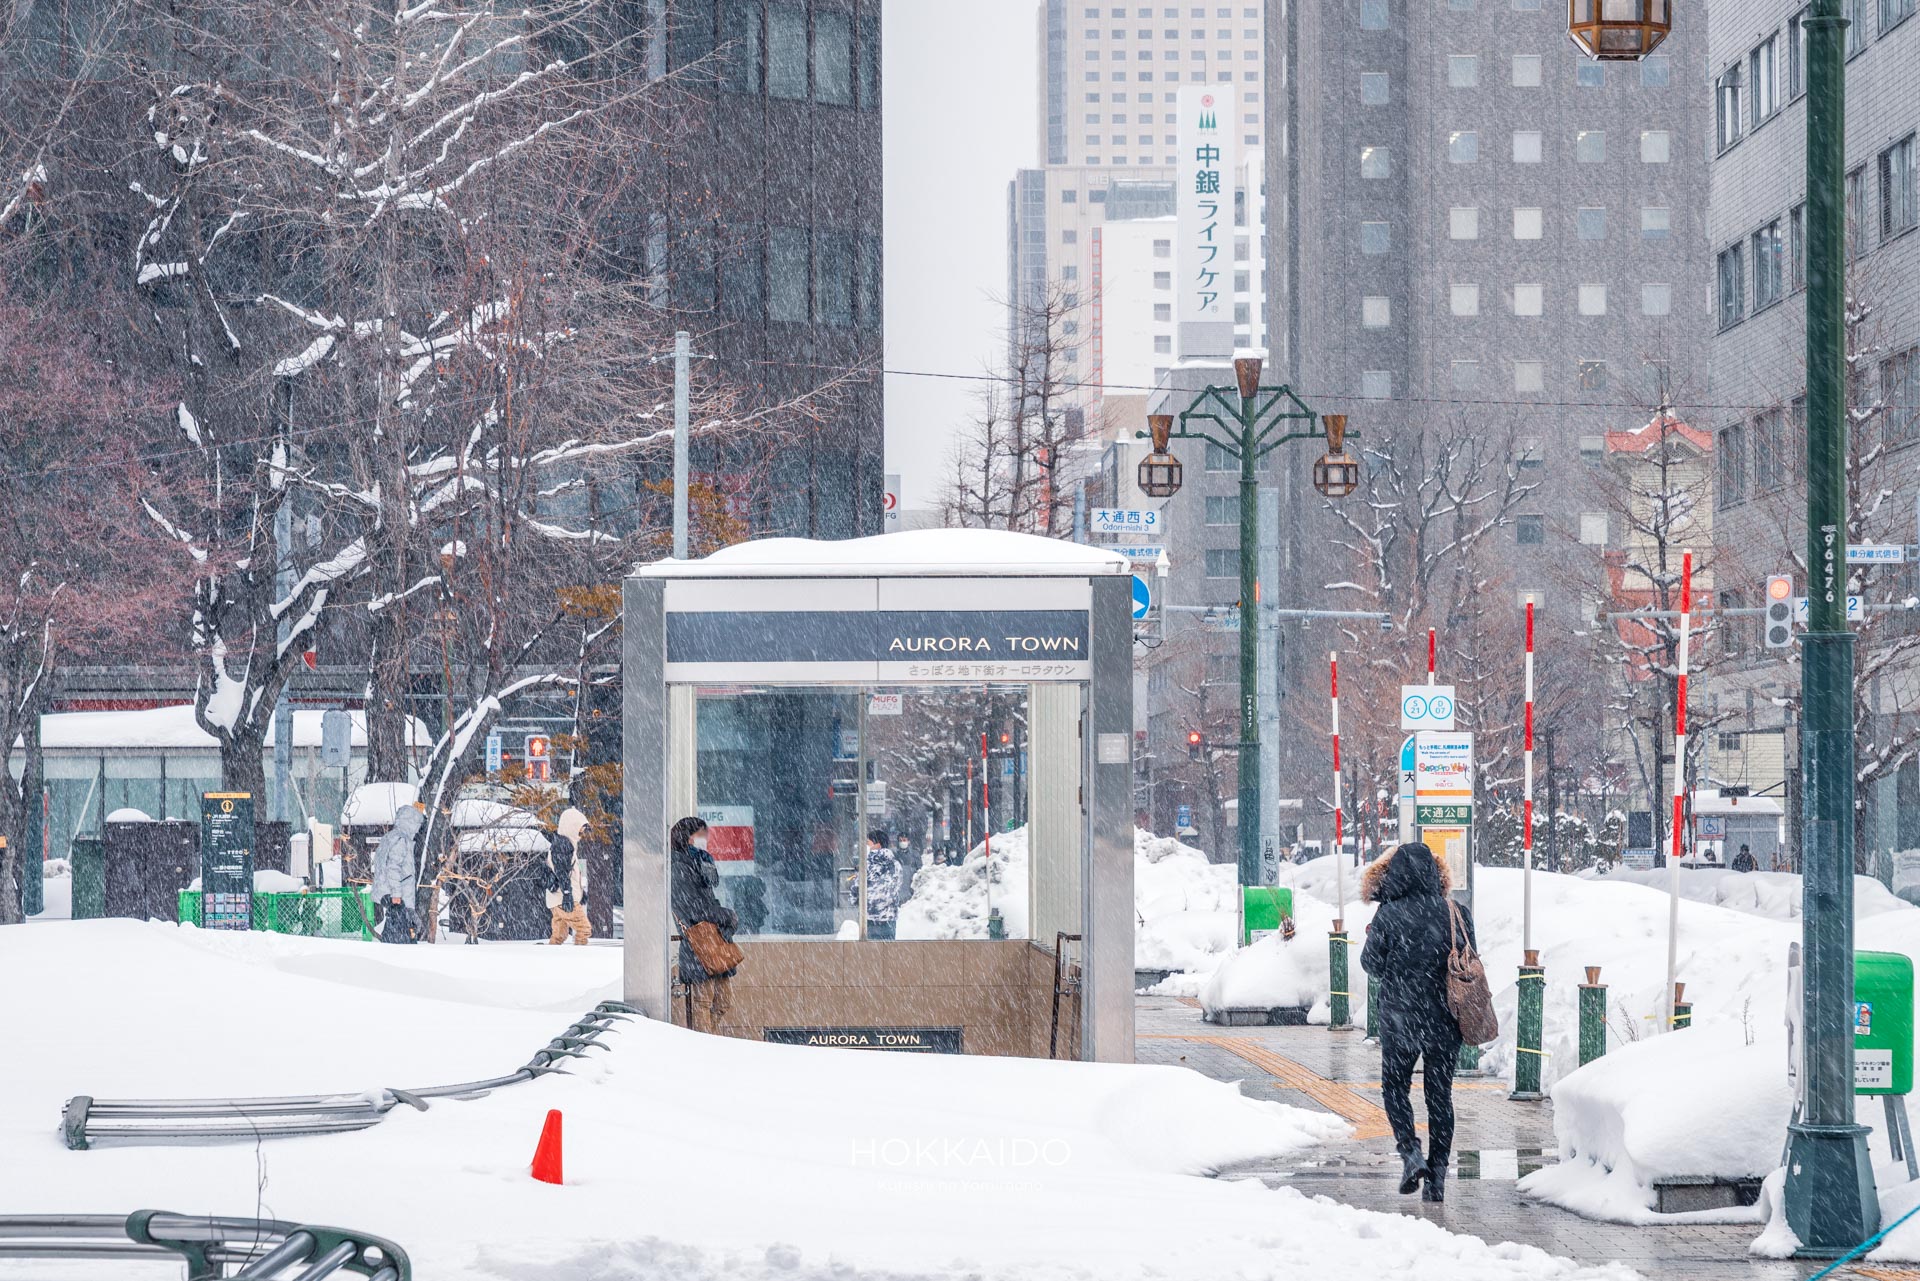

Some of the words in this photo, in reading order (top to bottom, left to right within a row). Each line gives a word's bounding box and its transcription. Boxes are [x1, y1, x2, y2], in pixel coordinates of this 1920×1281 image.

[1195, 143, 1220, 312] 中銀ライフケア
[1102, 523, 1143, 532] Odori-nishi
[1143, 523, 1149, 532] 3
[1824, 534, 1834, 602] 96476
[1848, 598, 1858, 611] 2
[889, 637, 991, 652] AURORA
[1005, 636, 1080, 652] TOWN
[872, 703, 898, 711] PLAZA
[1418, 762, 1450, 773] Sapporo
[1420, 806, 1468, 818] 大通公園
[808, 1034, 869, 1045] AURORA
[876, 1034, 921, 1045] TOWN
